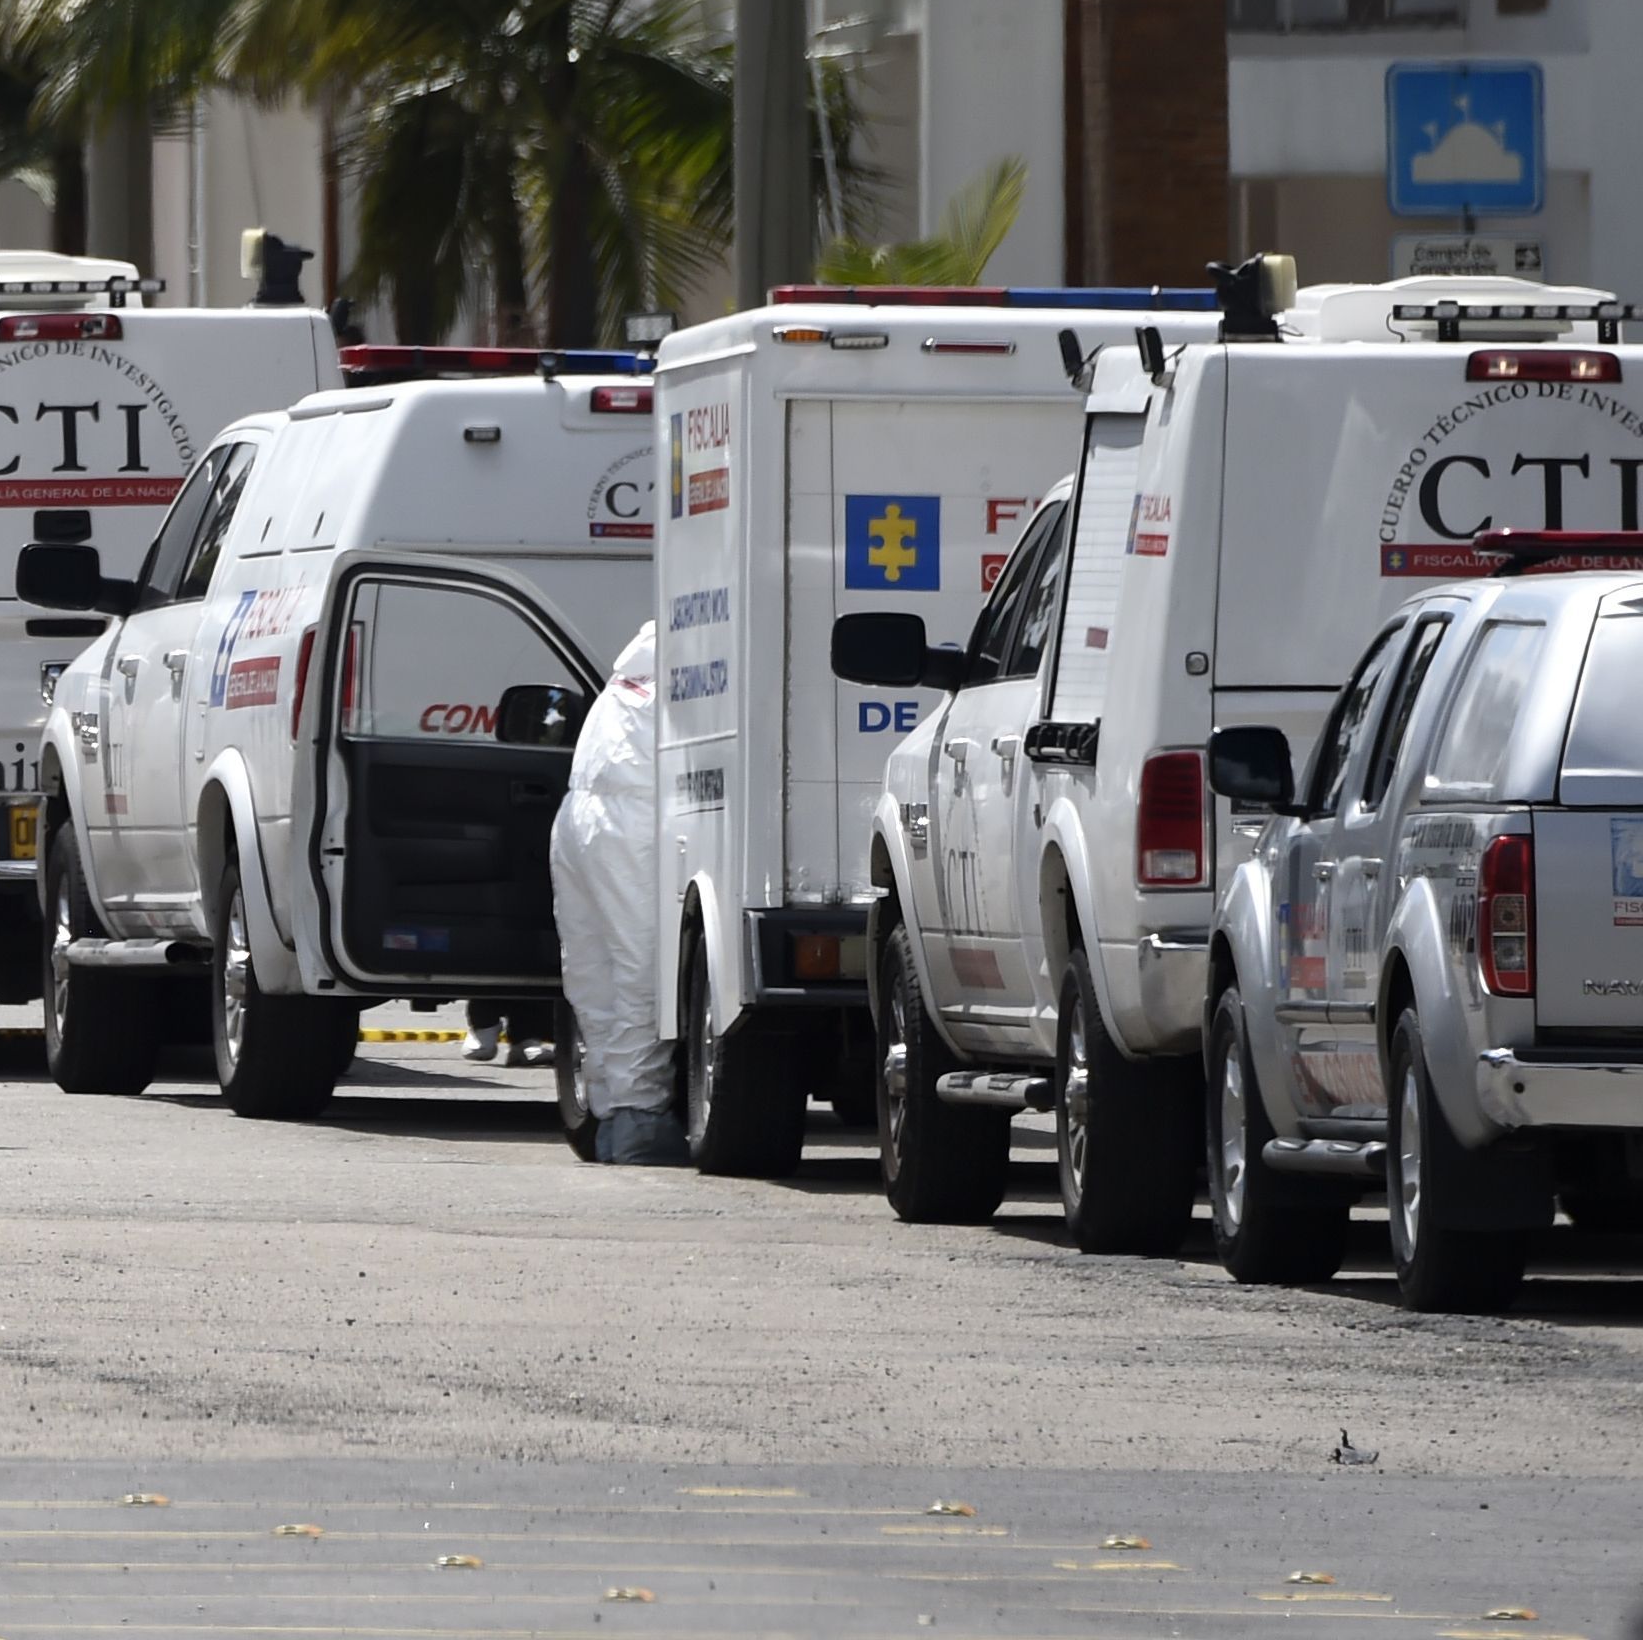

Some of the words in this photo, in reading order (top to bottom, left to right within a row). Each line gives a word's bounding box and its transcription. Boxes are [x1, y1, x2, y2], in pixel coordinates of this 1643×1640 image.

[56, 340, 85, 357] DE
[1379, 447, 1428, 544] CUERPO
[1423, 381, 1530, 448] TÉCNICO
[1536, 381, 1574, 402] DE
[22, 487, 88, 499] GENERAL
[92, 487, 112, 498] DE
[116, 487, 135, 498] LA
[1419, 452, 1643, 540] CTI
[1581, 556, 1605, 568] DE
[1609, 556, 1631, 569] LA
[858, 702, 919, 733] DE
[1583, 979, 1643, 996] NAV
